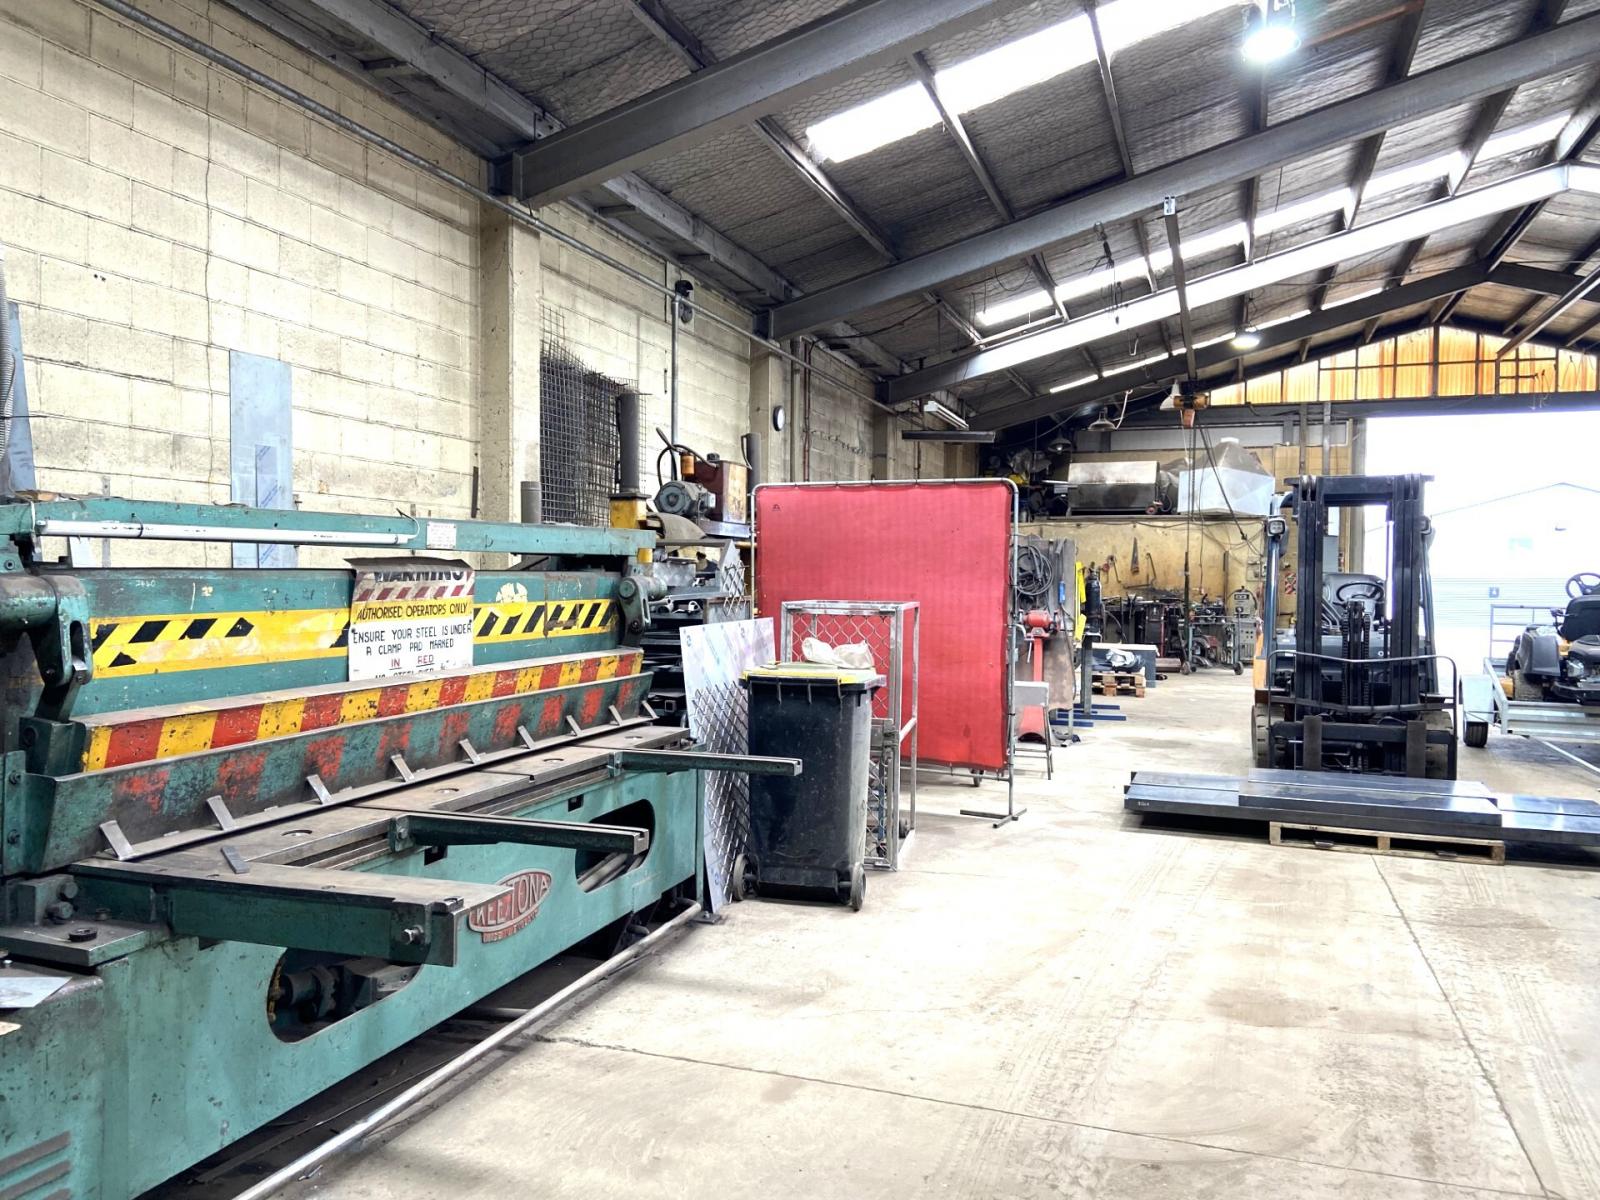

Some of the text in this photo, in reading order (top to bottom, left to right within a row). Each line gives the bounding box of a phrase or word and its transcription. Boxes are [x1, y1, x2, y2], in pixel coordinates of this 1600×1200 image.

[357, 603, 467, 620] AUTHORISED OPERATORS ONLY
[353, 623, 471, 643] ENSURE YOUR STEEL IS UNDER
[366, 638, 454, 656] A CLAMP PAD MARKED
[391, 655, 434, 668] IN RED
